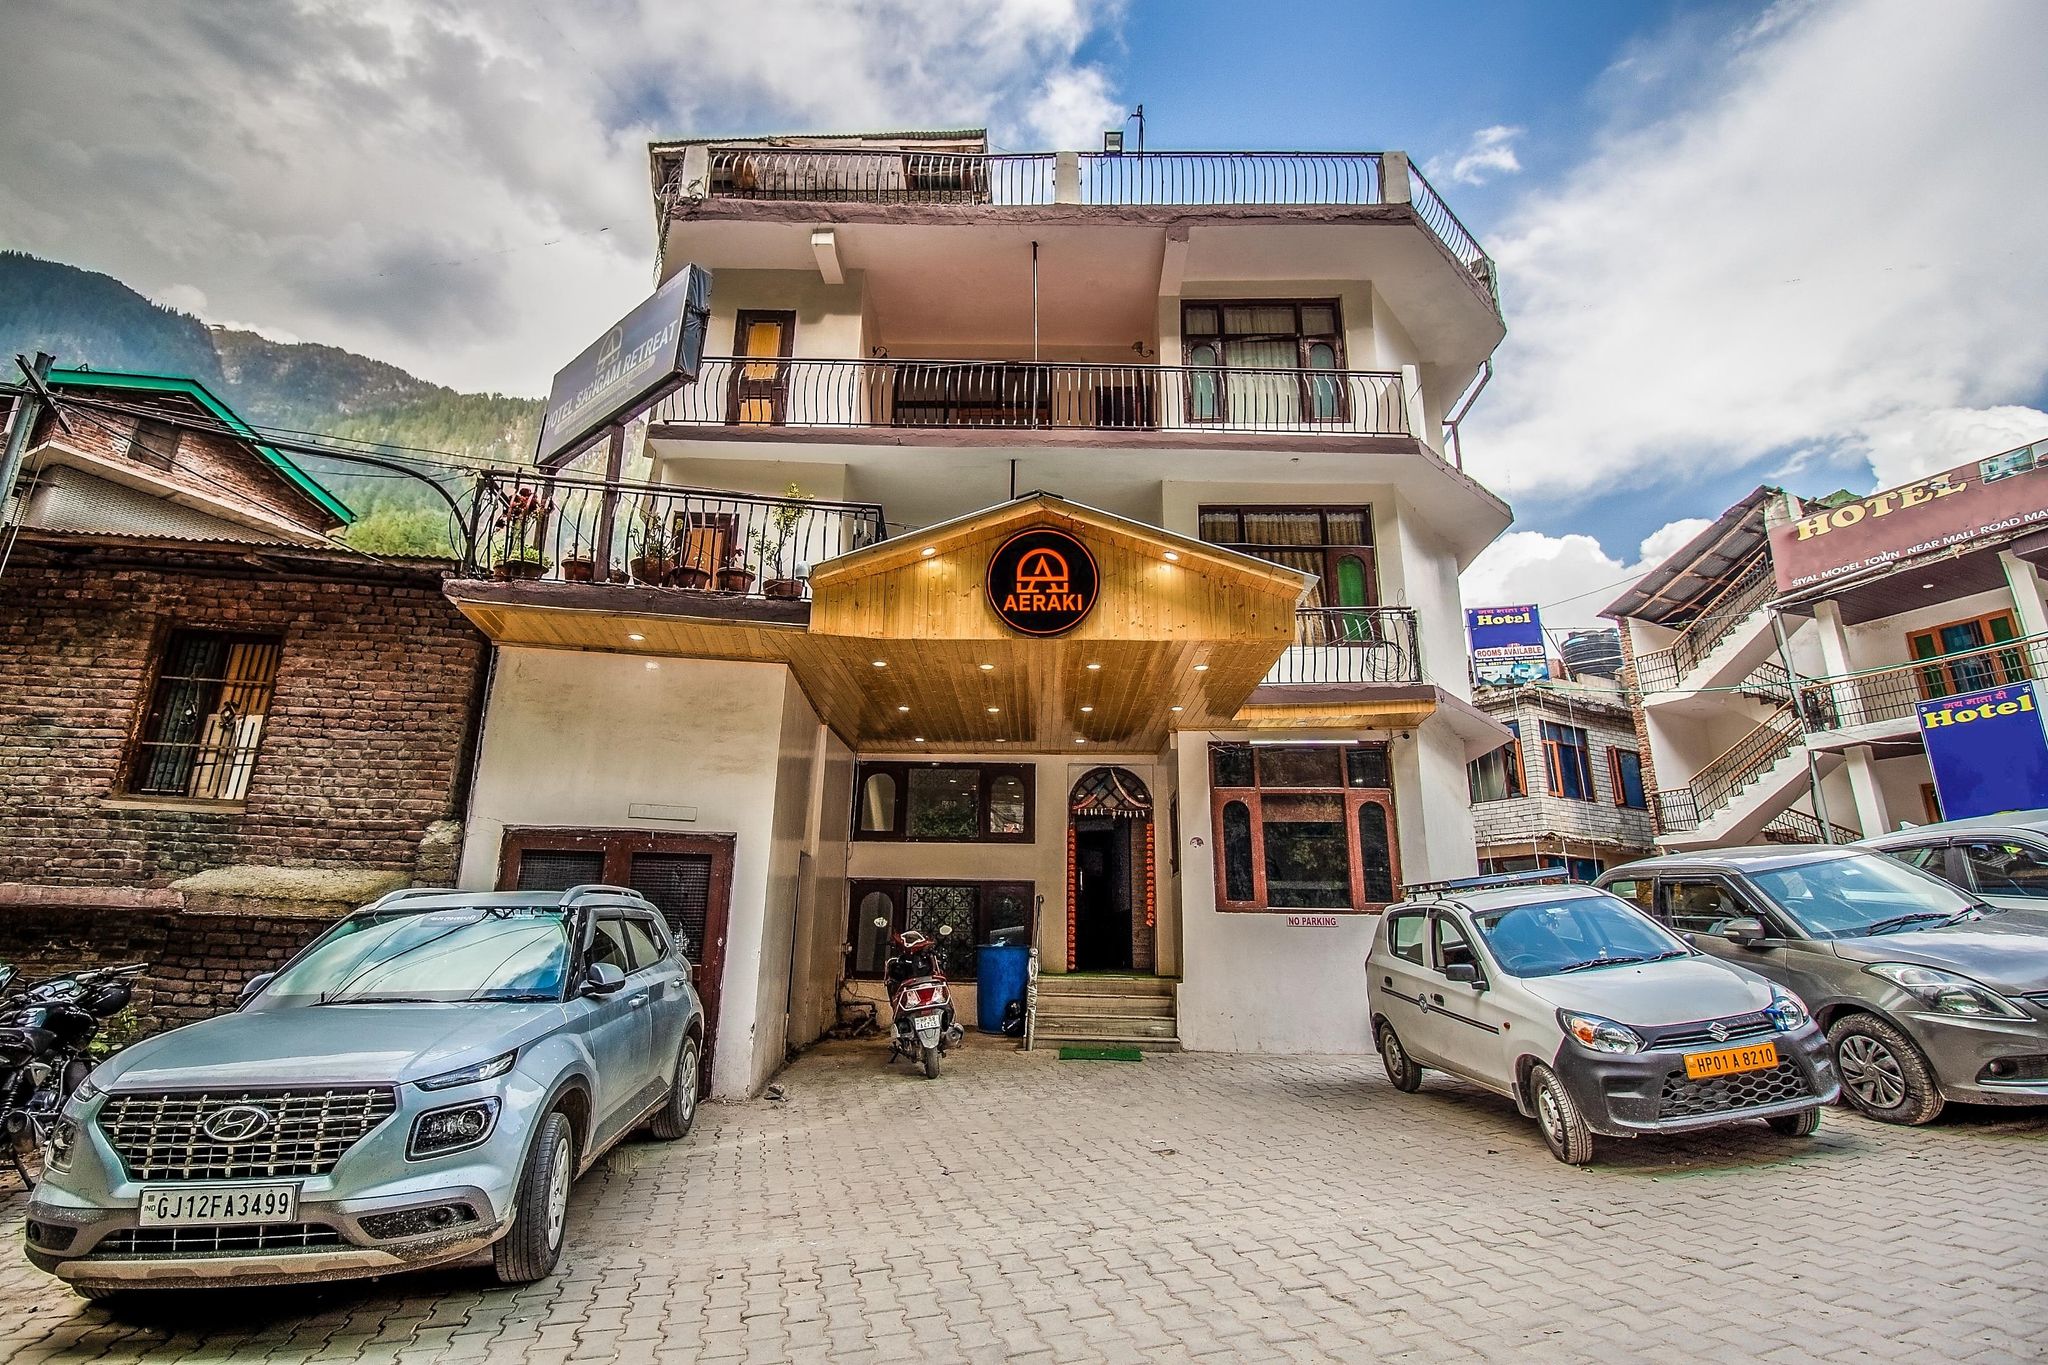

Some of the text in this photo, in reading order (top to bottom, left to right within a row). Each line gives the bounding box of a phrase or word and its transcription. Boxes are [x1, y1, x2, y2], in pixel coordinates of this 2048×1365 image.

[623, 320, 678, 374] RETREAT
[1795, 473, 1968, 541] HOTEL
[1792, 574, 1819, 586] SIYAL
[1863, 550, 1900, 567] TOWN
[1906, 539, 1939, 555] NEAR
[1942, 529, 1975, 545] MALL
[1980, 517, 2021, 535] ROAD
[2023, 508, 2048, 523] MA
[1003, 594, 1083, 611] AERAKI
[1477, 613, 1531, 626] Hotel
[1477, 646, 1541, 658] ROOMS AVAILABLE
[1922, 694, 2035, 729] Hotel
[1288, 917, 1337, 926] NO PARKING
[1697, 1048, 1773, 1072] HP01 A 8210
[157, 1192, 289, 1219] GJ12FA3499
